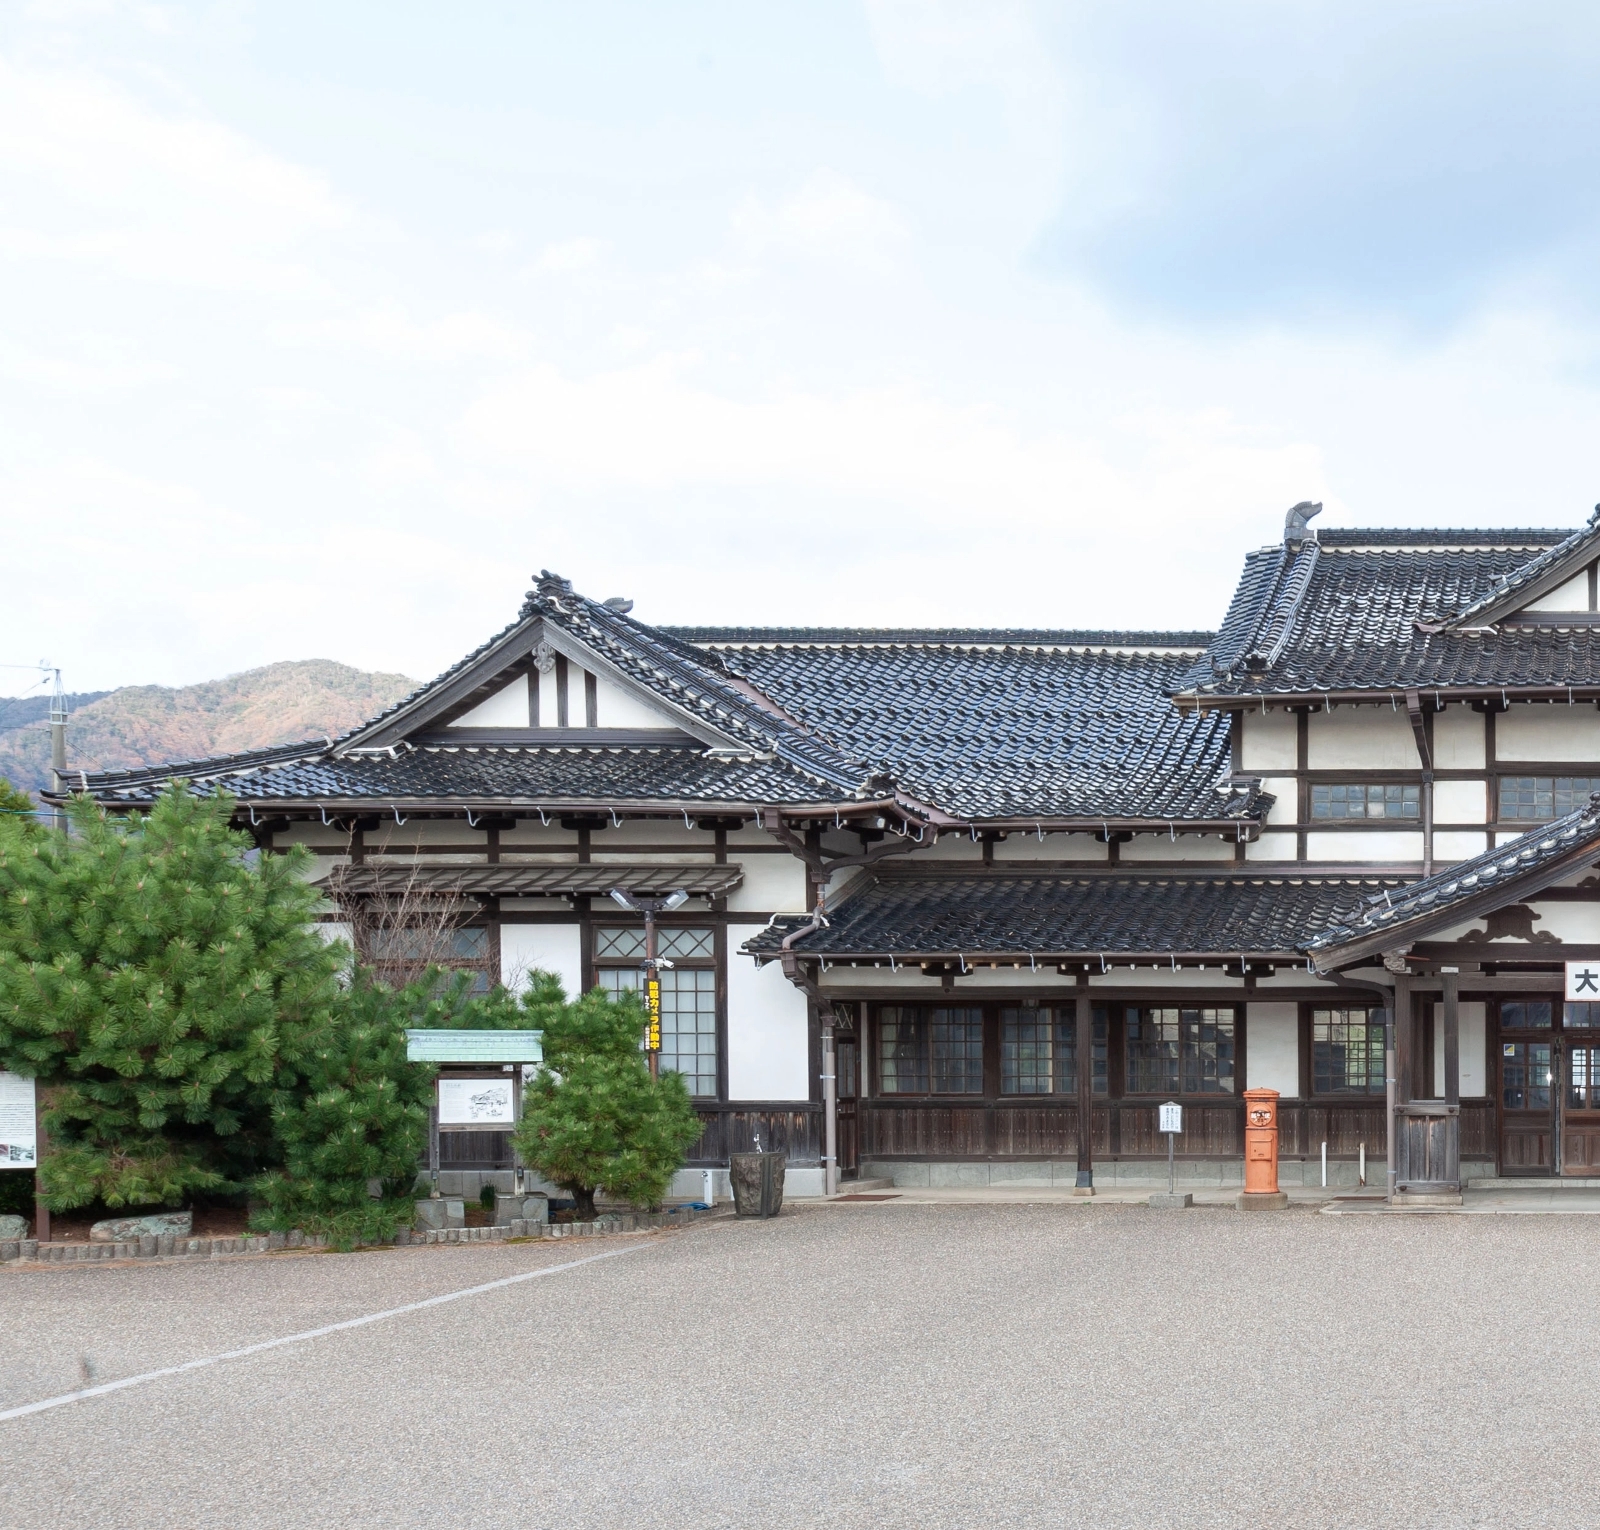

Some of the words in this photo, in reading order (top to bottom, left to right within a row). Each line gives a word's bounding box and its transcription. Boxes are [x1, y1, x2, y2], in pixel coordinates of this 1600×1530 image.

[649, 981, 660, 1050] 防犯カメラ作動中
